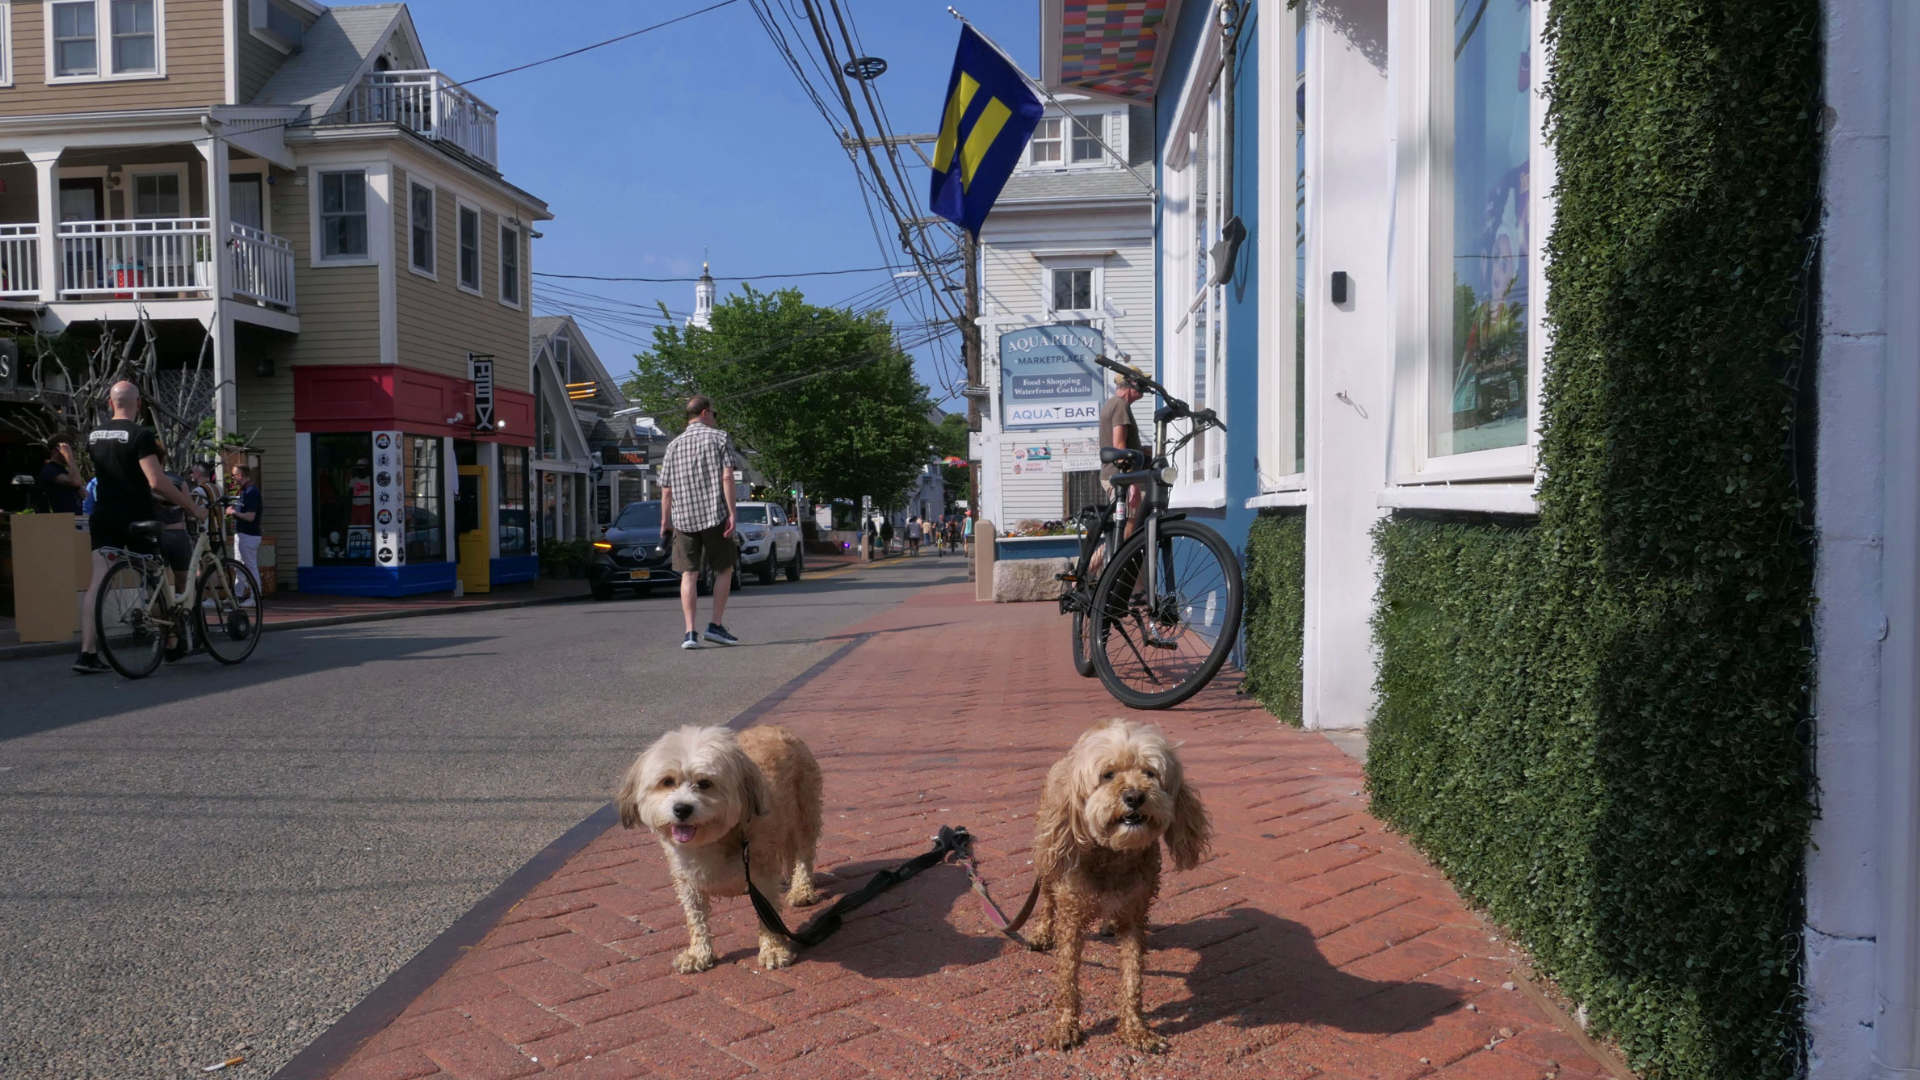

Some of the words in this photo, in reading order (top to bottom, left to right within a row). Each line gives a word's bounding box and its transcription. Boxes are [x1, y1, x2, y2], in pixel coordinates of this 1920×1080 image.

[1007, 334, 1095, 353] AQUARIUM
[1018, 354, 1085, 365] MARKETPLACE
[1023, 378, 1041, 386] Food
[1046, 377, 1081, 387] Shopping
[1014, 387, 1054, 395] Waterfront
[1057, 385, 1091, 393] Cocktails
[1012, 408, 1053, 420] AQUA
[1065, 407, 1096, 418] BAR
